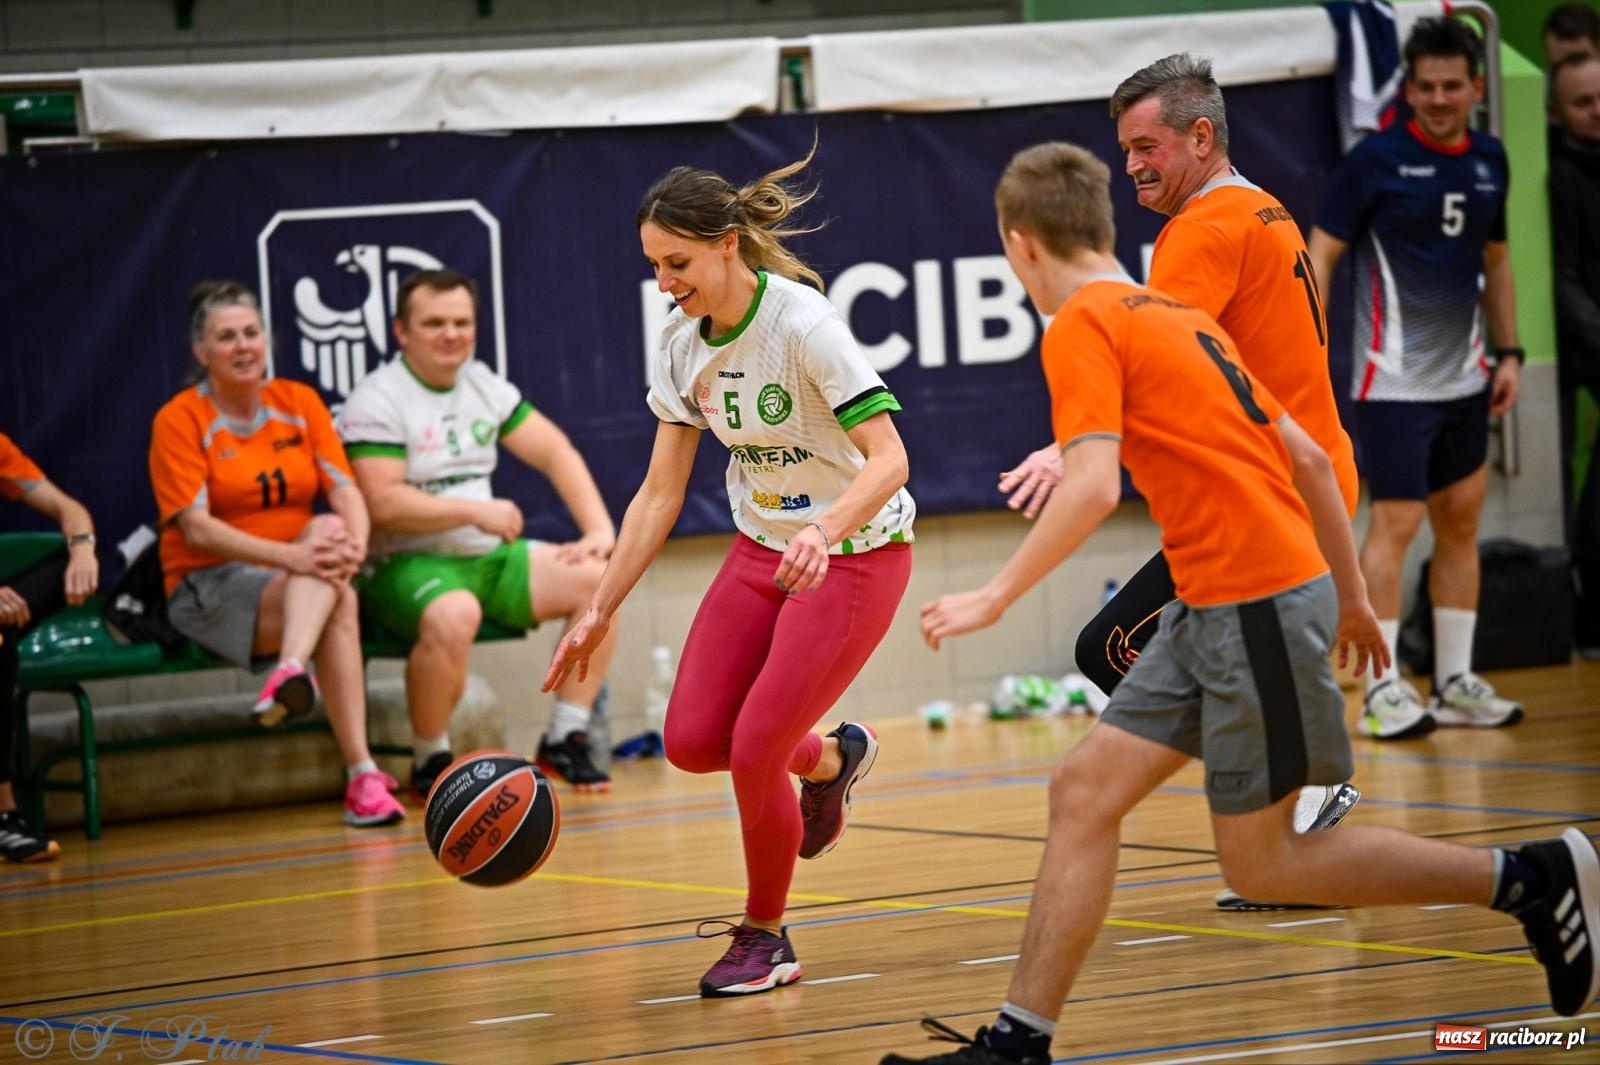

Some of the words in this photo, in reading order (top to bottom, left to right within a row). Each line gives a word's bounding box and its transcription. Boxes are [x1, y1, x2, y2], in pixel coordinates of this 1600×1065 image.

[1441, 193, 1467, 237] 5
[718, 371, 744, 379] DECTHLON
[1196, 330, 1270, 425] 6
[724, 391, 742, 430] 5
[256, 467, 287, 508] 11
[448, 785, 520, 864] SPALDING
